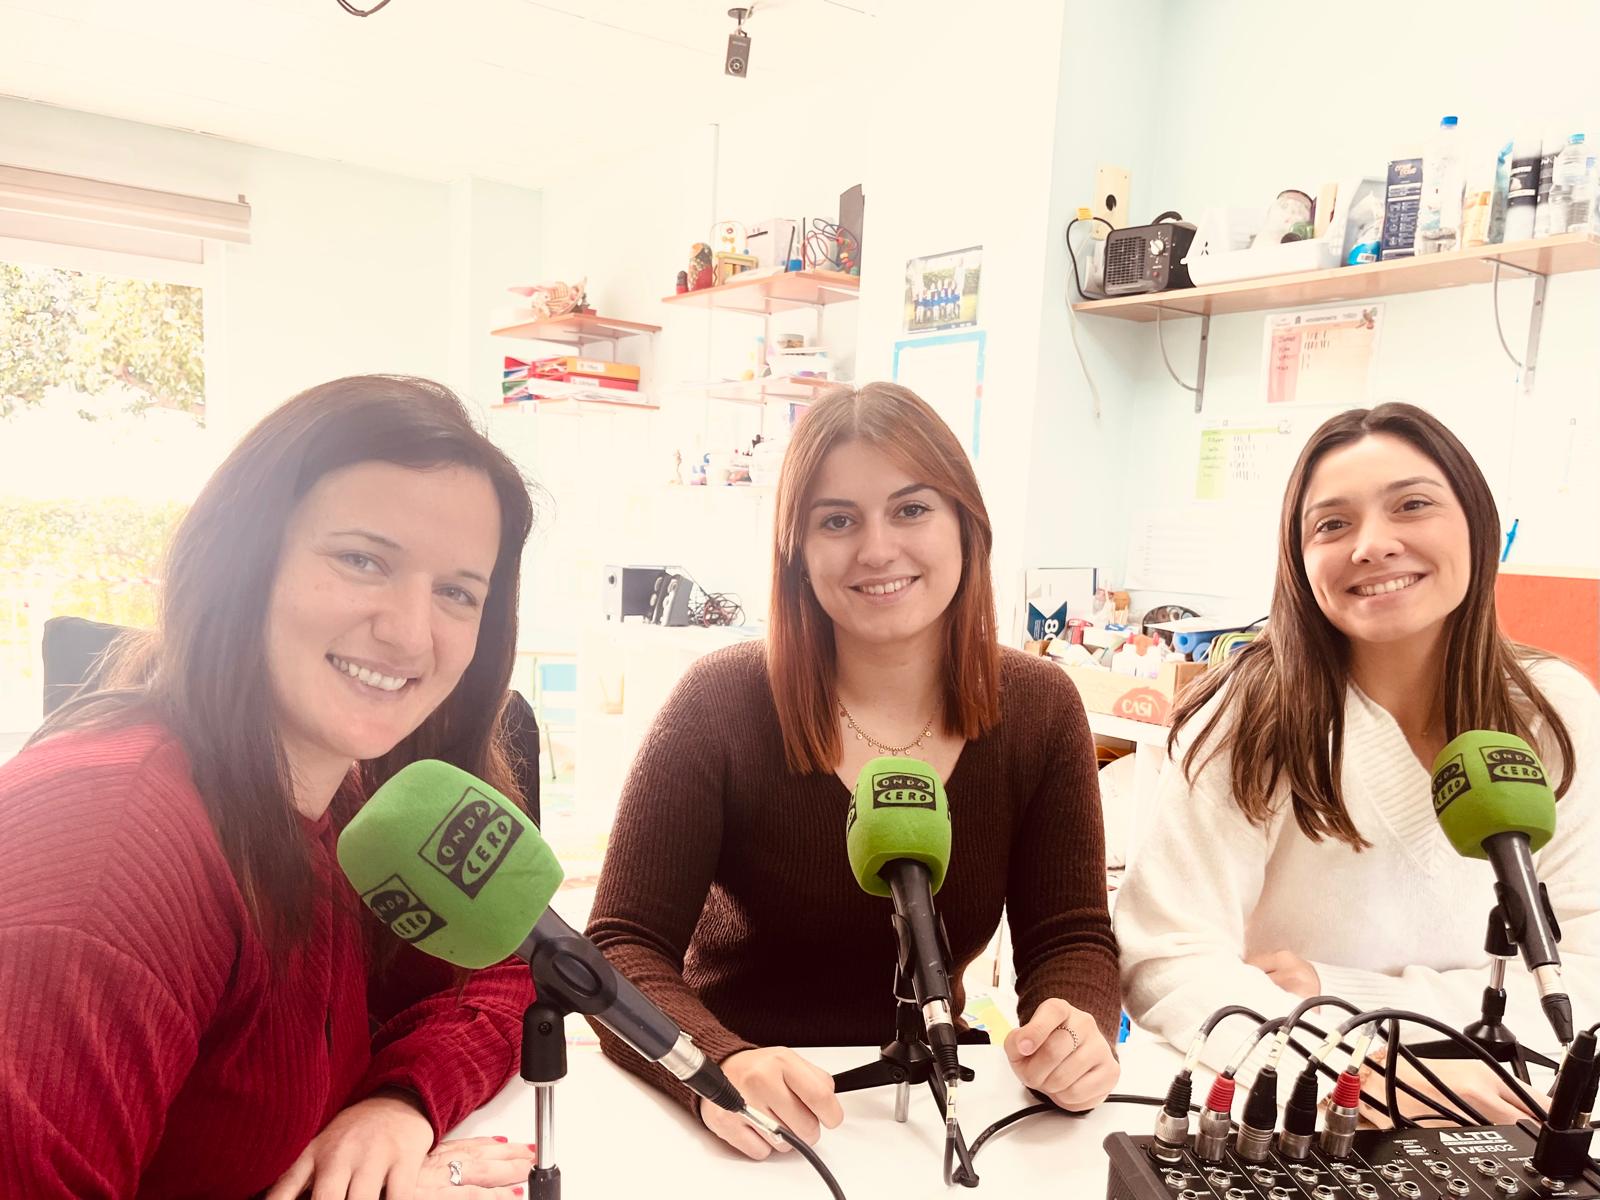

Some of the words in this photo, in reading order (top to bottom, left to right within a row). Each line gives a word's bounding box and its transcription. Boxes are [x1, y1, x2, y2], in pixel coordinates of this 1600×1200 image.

[1492, 752, 1531, 763] ONDA
[1500, 765, 1538, 778] CERO
[882, 779, 926, 788] ONDA
[884, 791, 927, 802] CERO
[1436, 780, 1460, 805] CERO
[441, 806, 486, 858] ONDA
[467, 821, 508, 874] CERO
[1439, 1131, 1503, 1142] ALTO
[1448, 1144, 1518, 1155] LIVE802
